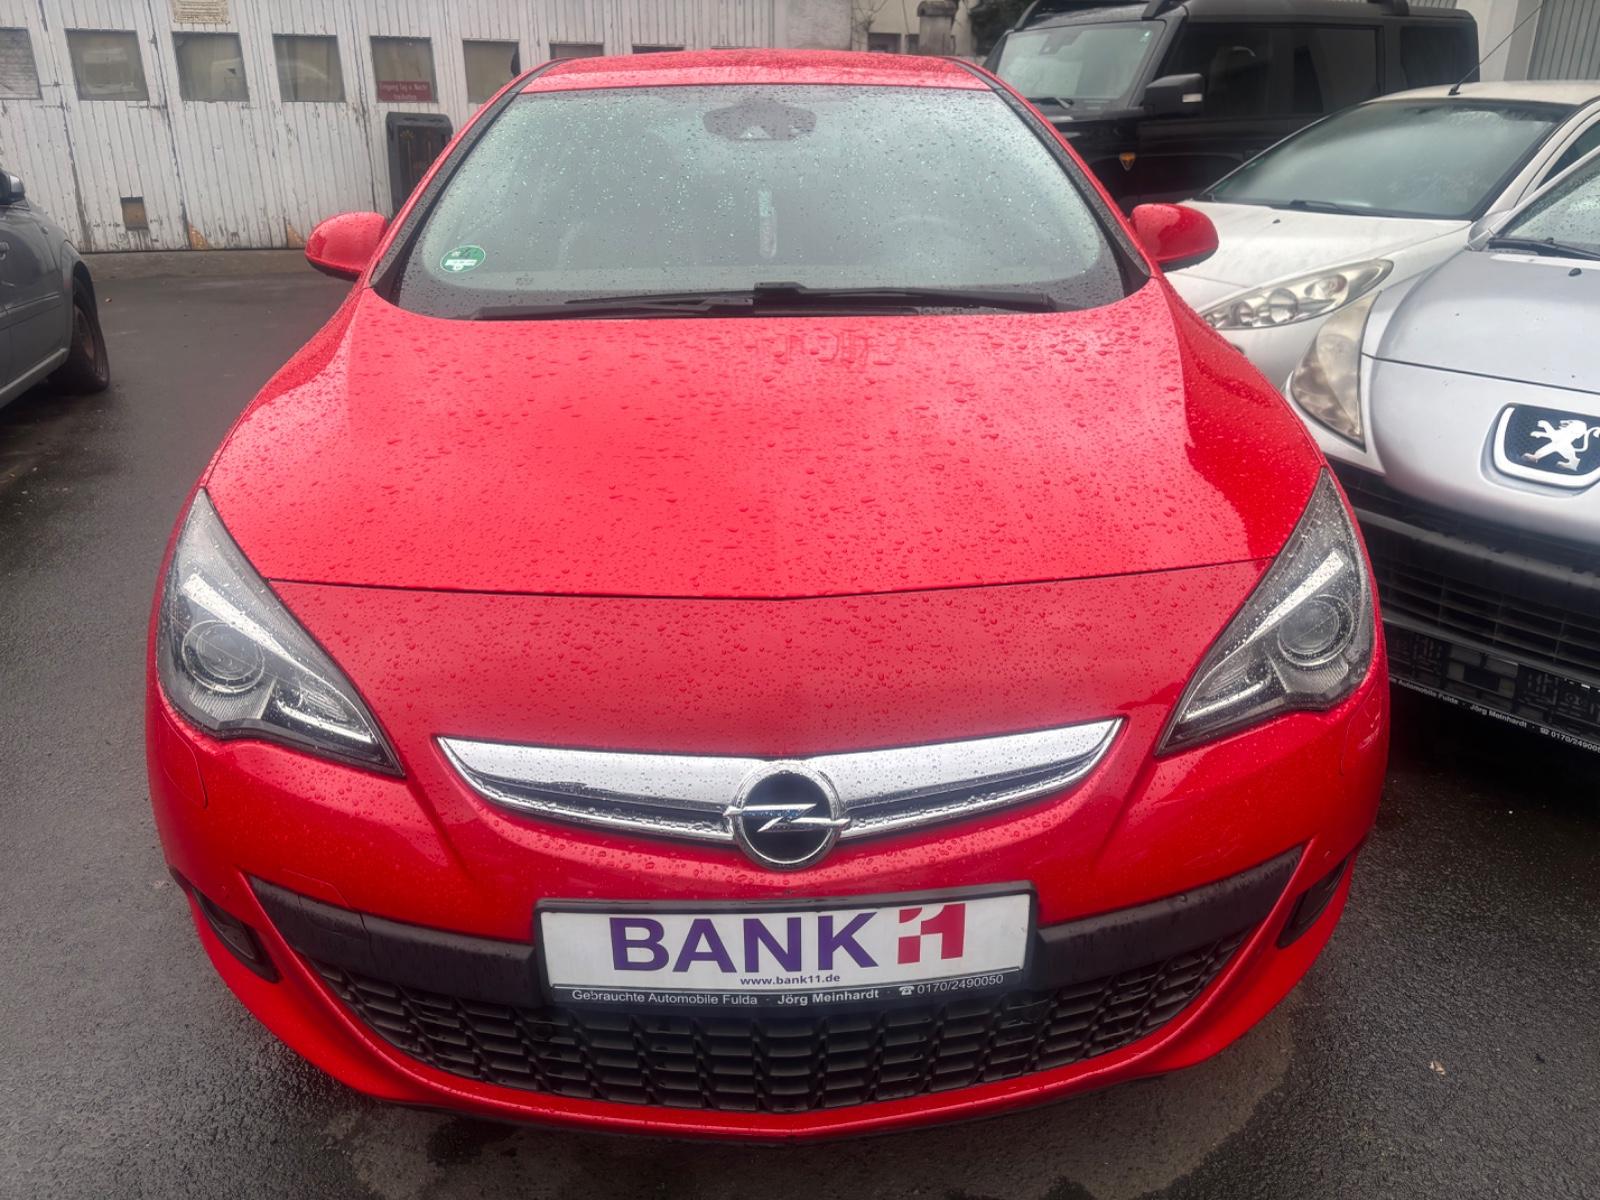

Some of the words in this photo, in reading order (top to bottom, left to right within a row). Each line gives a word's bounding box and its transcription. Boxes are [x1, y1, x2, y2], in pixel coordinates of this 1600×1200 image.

[1551, 730, 1600, 753] 0170/24900
[608, 911, 879, 974] BANK
[571, 989, 645, 1003] Gebrauchte
[648, 992, 719, 1005] Automobile
[722, 994, 758, 1005] Fulda
[777, 993, 808, 1006] Jörg
[812, 989, 879, 1004] Meinhardt
[917, 974, 1004, 995] 0170/2490050
[740, 974, 841, 985] www.bank11.de
